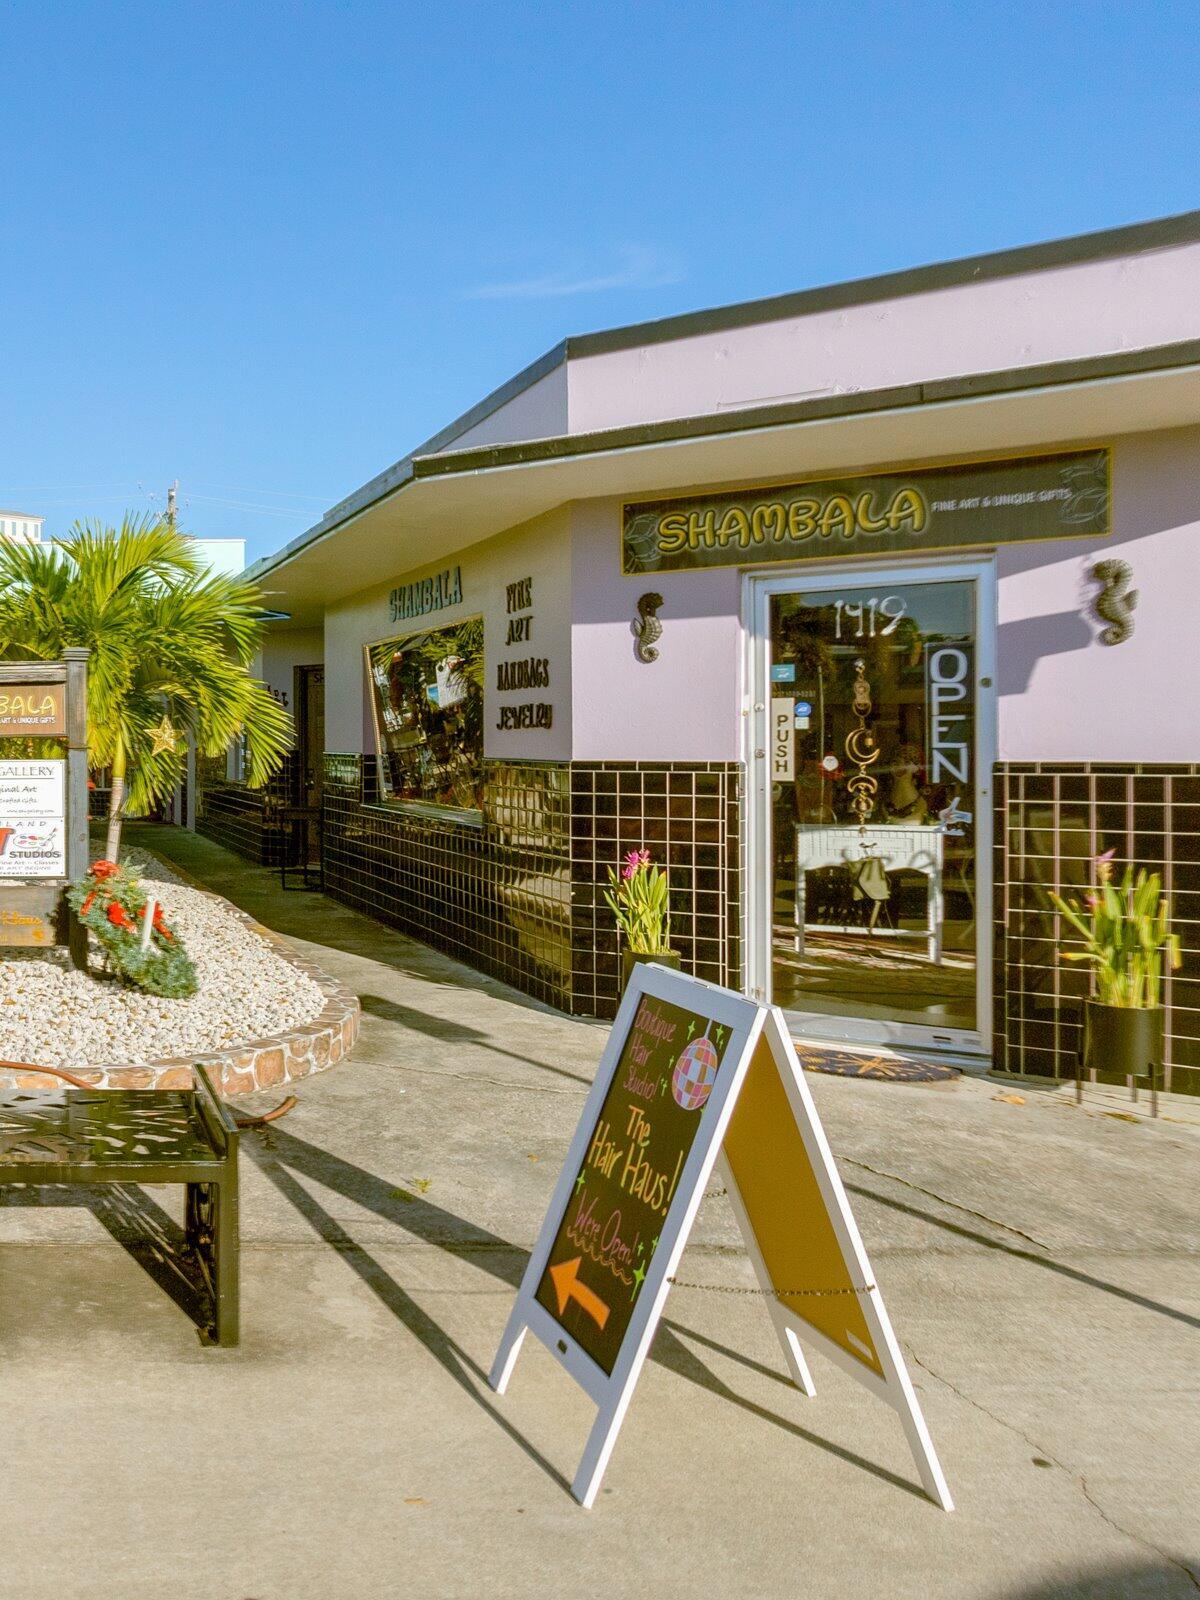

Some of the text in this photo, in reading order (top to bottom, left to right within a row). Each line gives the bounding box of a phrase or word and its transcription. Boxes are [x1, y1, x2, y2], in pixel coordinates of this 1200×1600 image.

[658, 488, 926, 552] SHAMBALA
[931, 500, 957, 512] FINE
[959, 497, 981, 510] ART
[992, 492, 1036, 506] UNIQUE
[388, 566, 463, 623] SHAMBALA
[506, 577, 532, 614] FINE
[505, 615, 533, 646] ART
[834, 594, 907, 639] 1419
[496, 657, 550, 691] HANDBAGS
[496, 702, 553, 730] JEWELRY
[929, 648, 969, 784] OPEN
[775, 715, 789, 773] PUSH
[22, 785, 37, 793] Art
[9, 850, 61, 859] STUDIOS
[629, 1032, 654, 1066] Hair
[623, 1065, 663, 1102] Studio!
[626, 1104, 651, 1147] The
[588, 1119, 683, 1217] Hair Haus!
[601, 1209, 640, 1265] Open!
